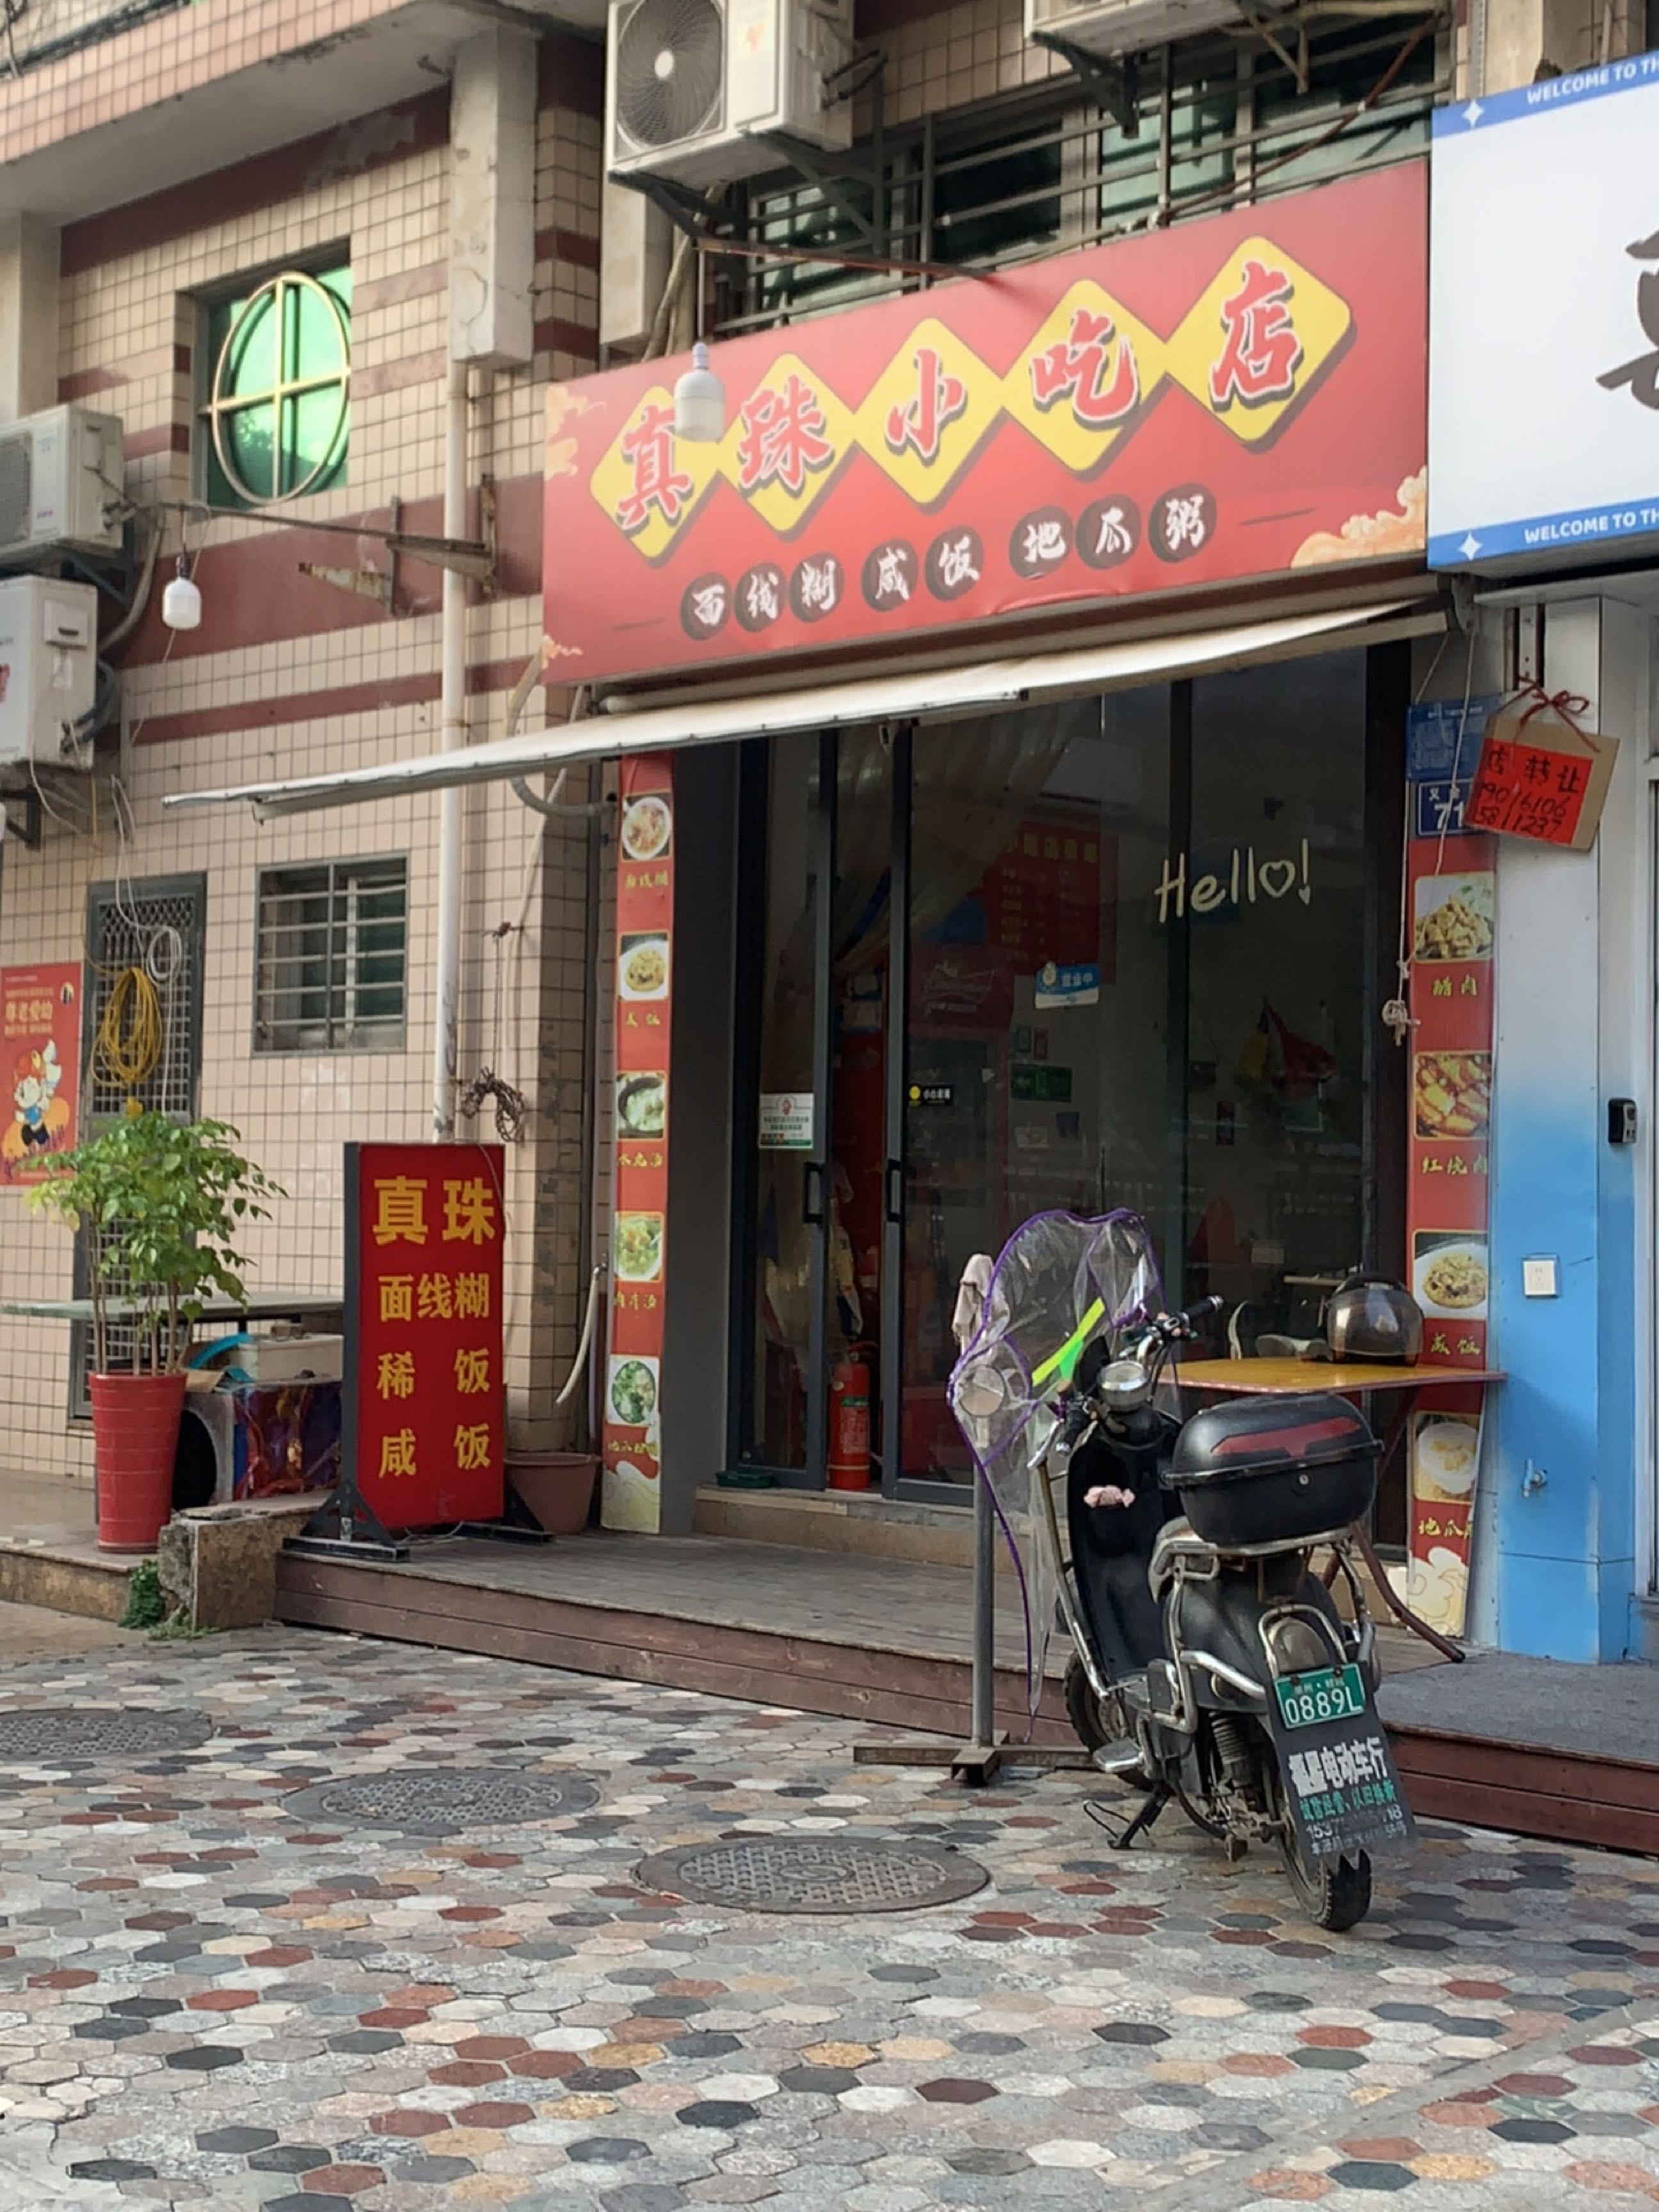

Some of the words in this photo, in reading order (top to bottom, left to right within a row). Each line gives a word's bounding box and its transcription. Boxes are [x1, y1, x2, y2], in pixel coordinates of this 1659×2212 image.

[1527, 68, 1609, 105] WELCOME
[1614, 63, 1637, 81] TO
[616, 259, 1303, 533] 真珠小吃店
[1524, 515, 1609, 544] WELCOME
[1613, 511, 1637, 529] TO
[691, 561, 838, 627] 面线糊
[872, 540, 983, 605] 咸饭
[1023, 493, 1208, 566] 地瓜粥
[1487, 744, 1581, 794] 店转让
[1154, 838, 1310, 924] Hello!
[373, 1175, 496, 1246] 真珠
[378, 1272, 490, 1322] 面线糊
[377, 1347, 490, 1400] 稀饭
[378, 1423, 490, 1477] 咸饭
[1285, 1686, 1364, 1724] 0889L
[1288, 1736, 1388, 1798] 电动车行
